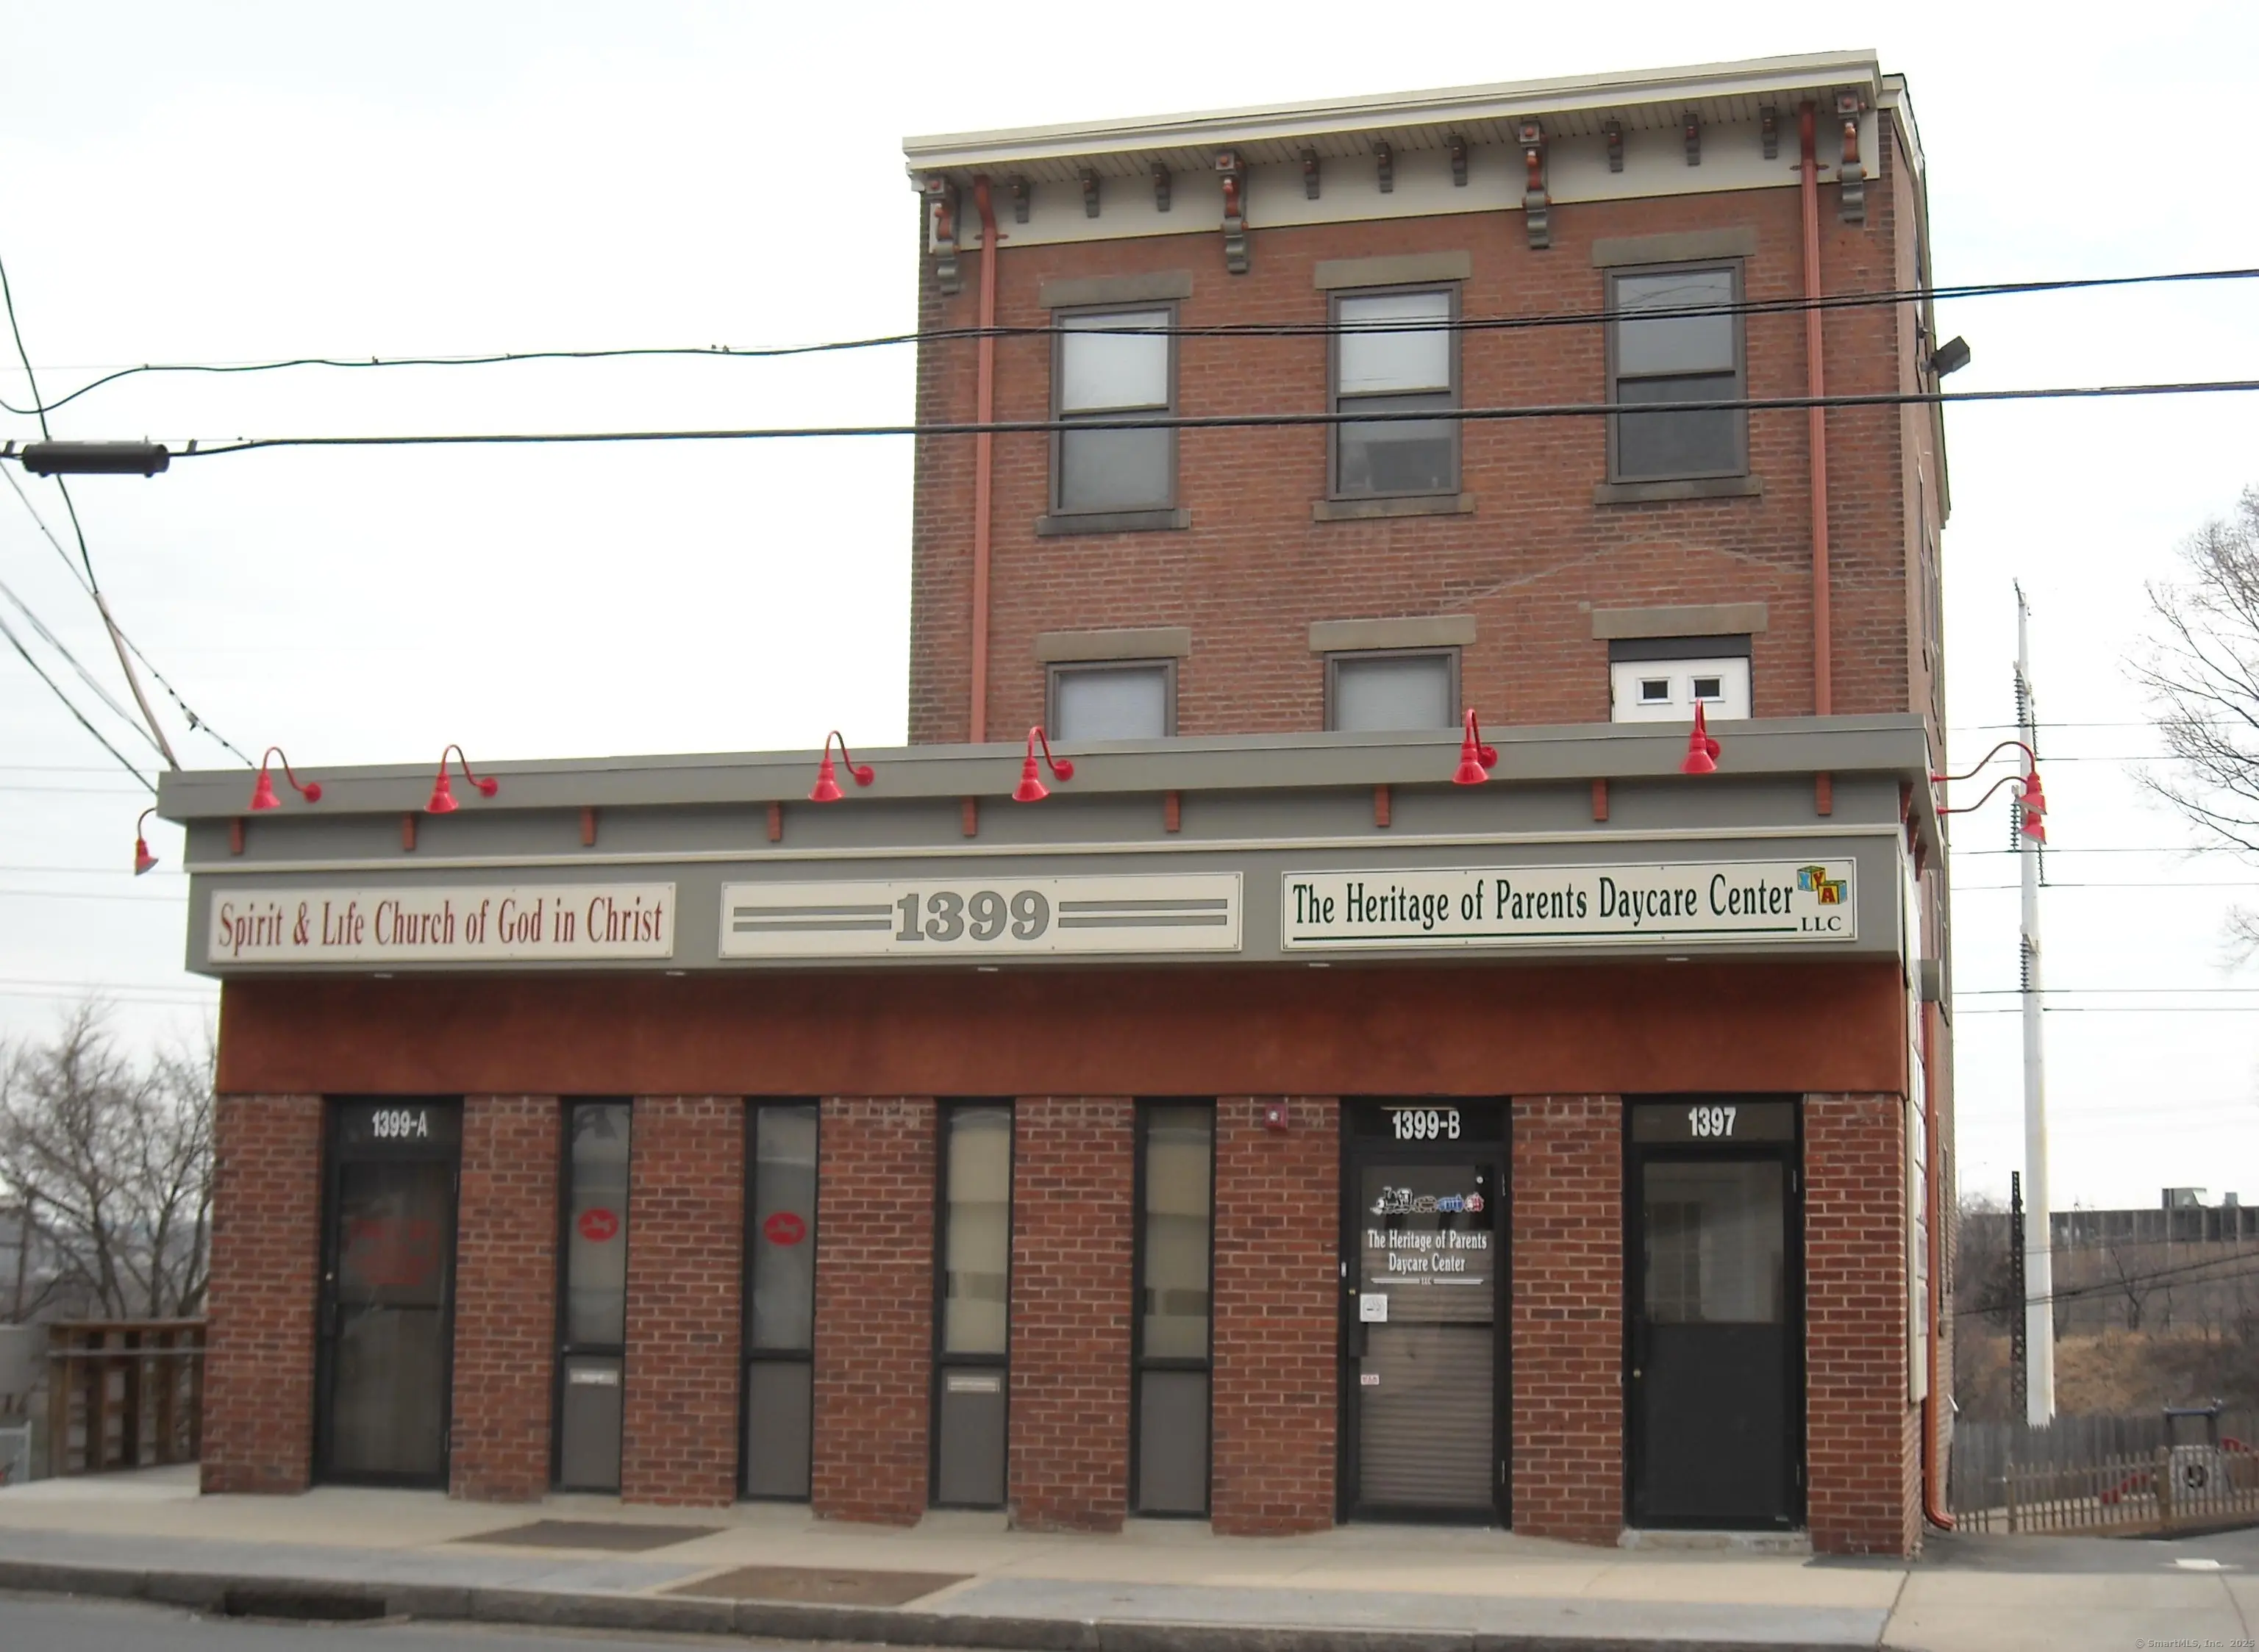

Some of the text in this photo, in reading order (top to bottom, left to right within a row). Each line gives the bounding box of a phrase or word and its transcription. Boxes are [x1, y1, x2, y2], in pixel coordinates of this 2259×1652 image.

[896, 890, 1050, 942] 1399
[1293, 873, 1794, 931] The Heritage of Parents Daycare Center
[219, 896, 663, 955] Spirit & Life Church of God in Christ
[1801, 916, 1842, 932] LLC
[372, 1110, 427, 1137] 1399-A
[1393, 1111, 1460, 1140] 1399-B
[1688, 1106, 1736, 1137] 1397
[1367, 1229, 1488, 1252] The Heritage of Parents
[1389, 1253, 1466, 1275] Daycare Center
